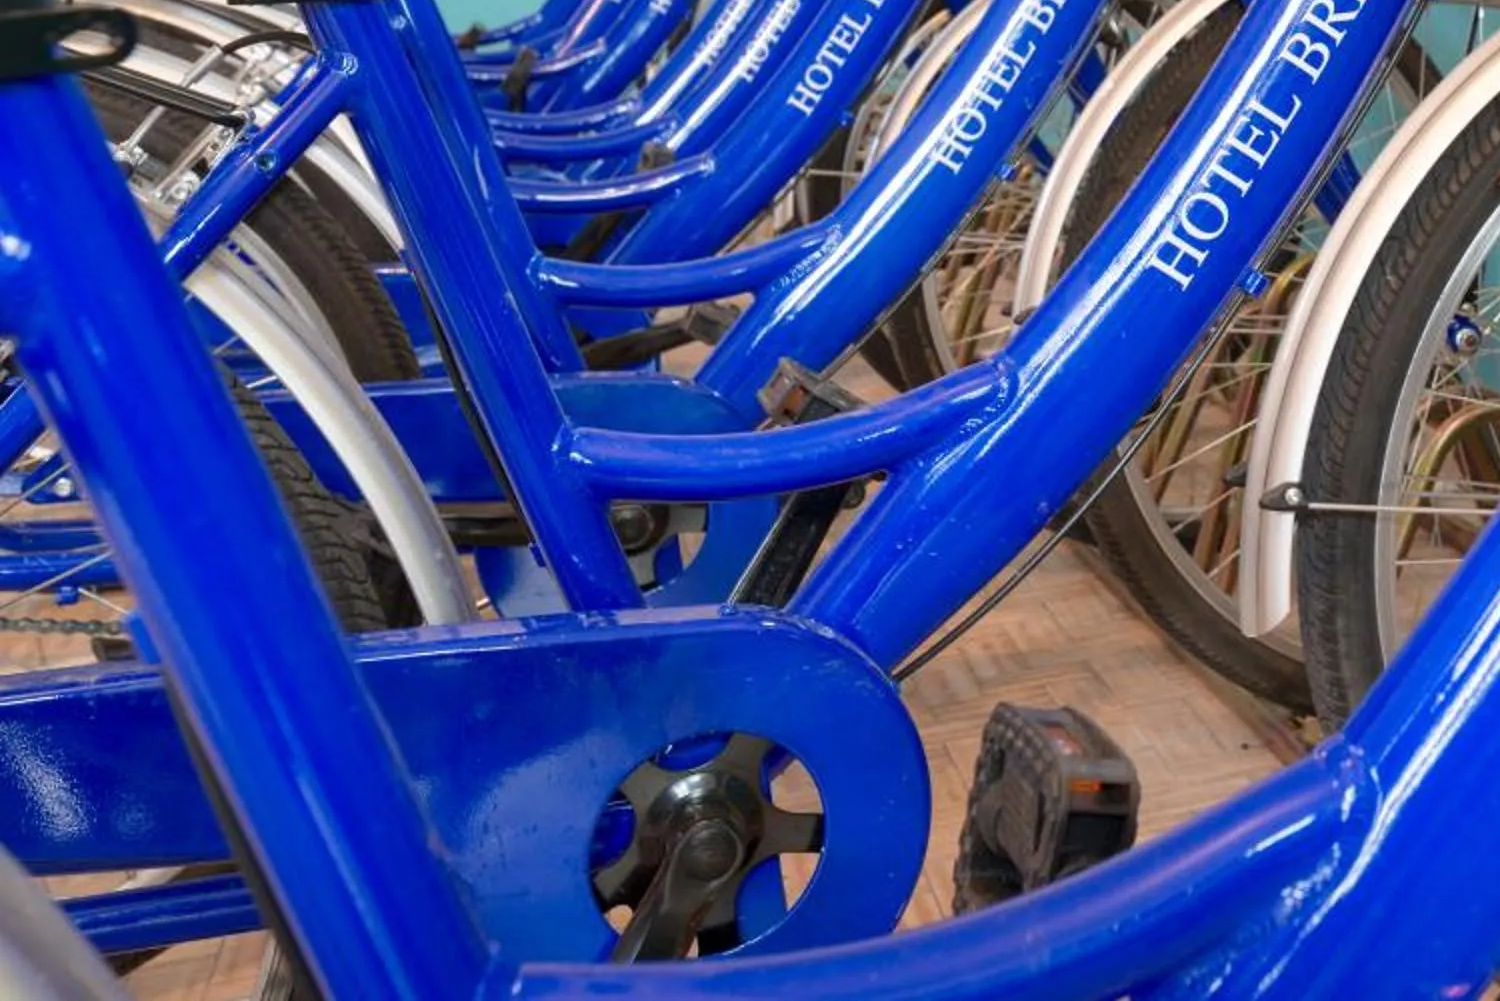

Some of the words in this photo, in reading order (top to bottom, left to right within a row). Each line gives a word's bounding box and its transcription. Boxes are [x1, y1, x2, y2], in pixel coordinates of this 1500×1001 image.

[786, 13, 873, 118] HOTEL
[931, 41, 1036, 175] HOTEL
[1147, 94, 1302, 291] HOTEL
